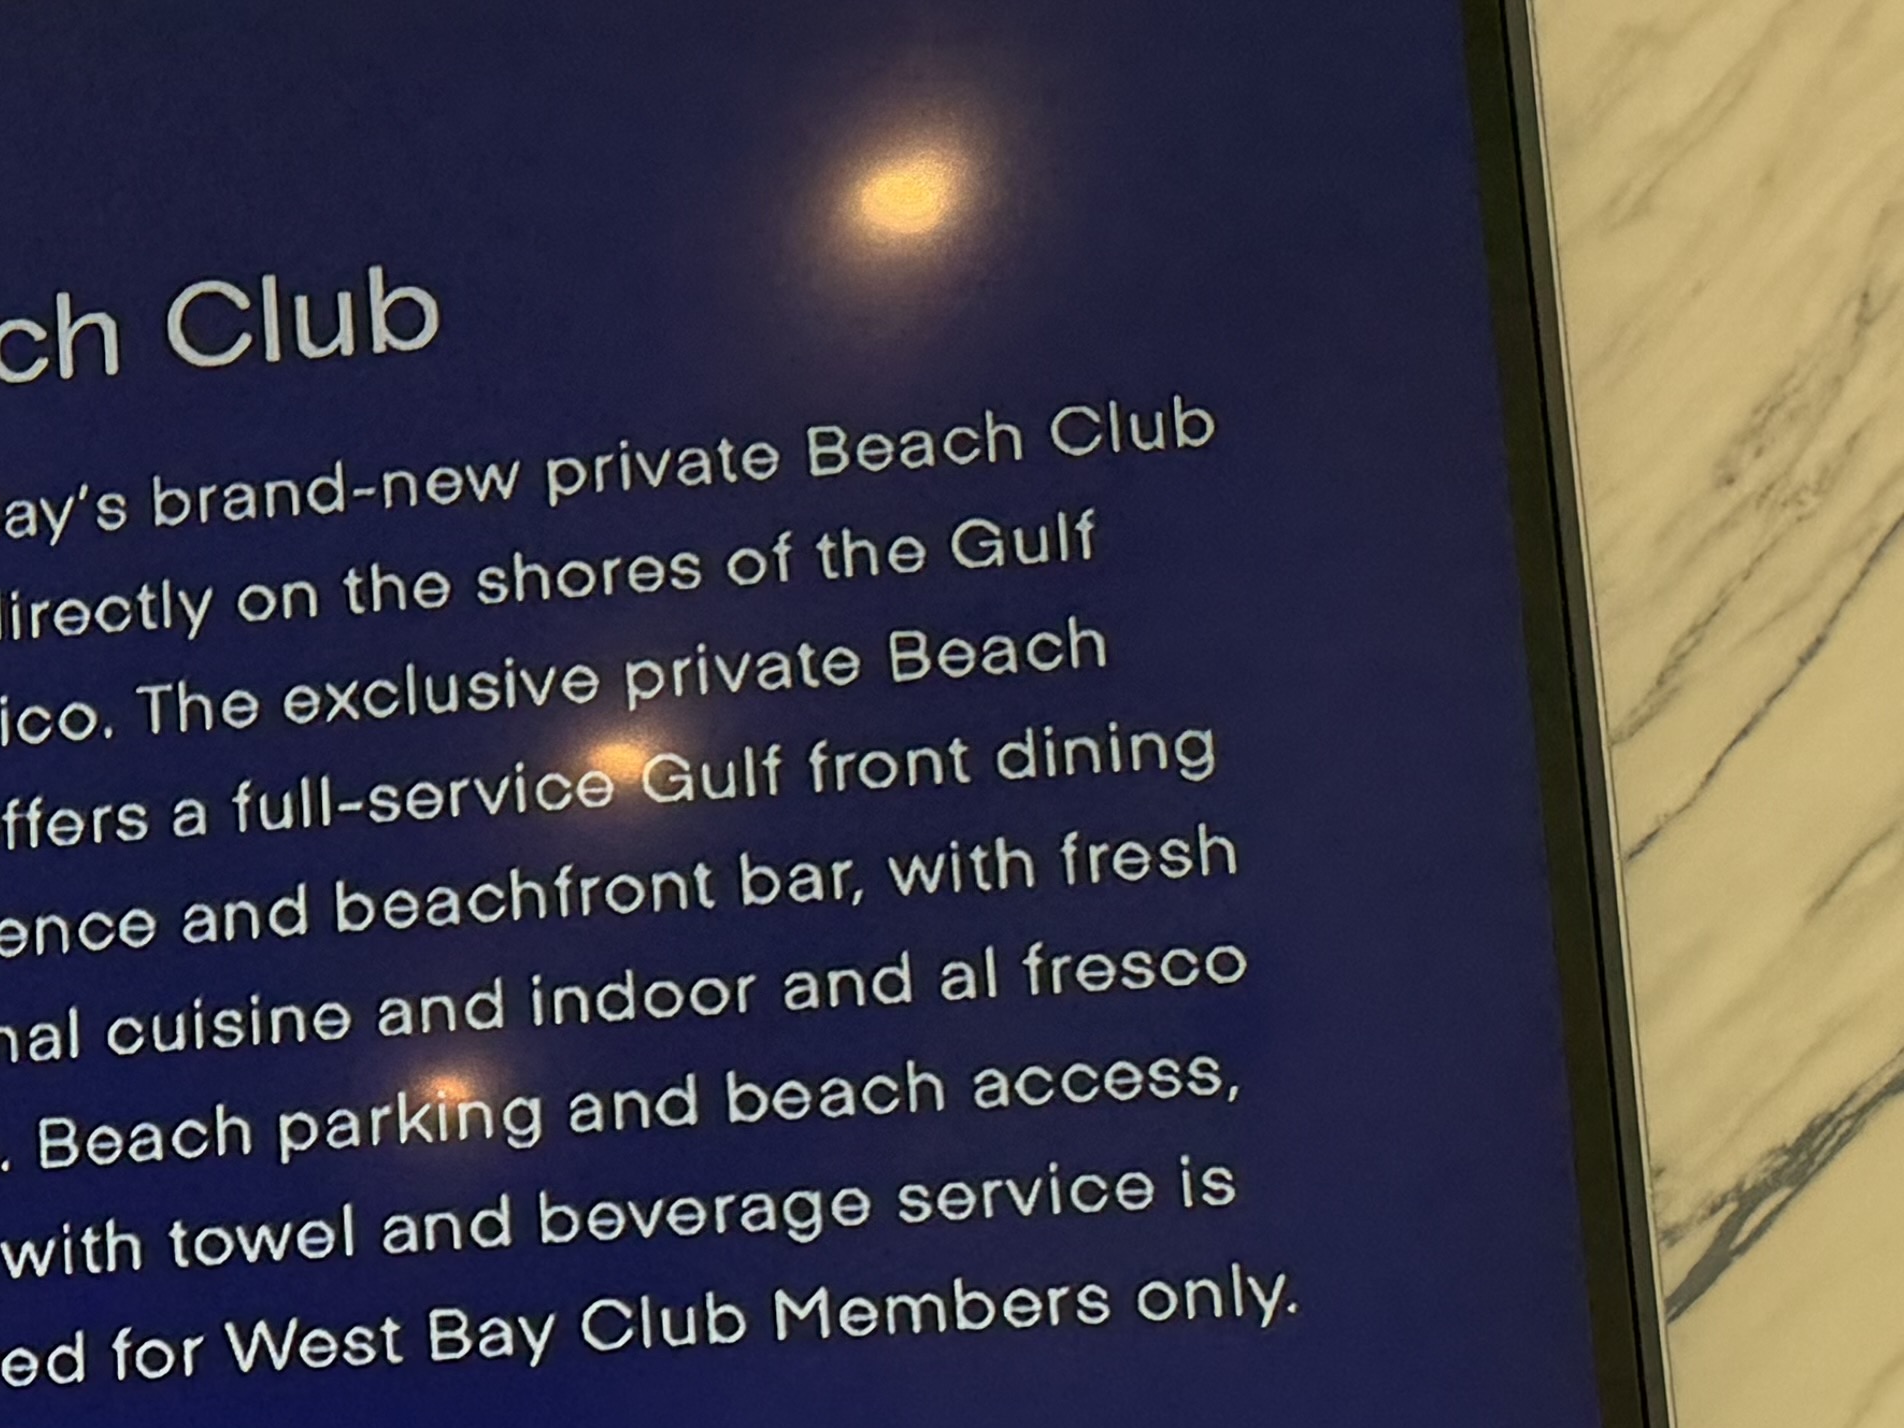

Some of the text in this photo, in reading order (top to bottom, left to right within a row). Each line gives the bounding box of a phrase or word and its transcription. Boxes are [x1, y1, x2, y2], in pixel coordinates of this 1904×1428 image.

[168, 266, 438, 366] Club
[153, 461, 519, 526] brand-new
[547, 438, 779, 506] private
[807, 410, 1021, 476] Beach
[1051, 395, 1214, 455] Club
[238, 581, 317, 621] on
[343, 563, 450, 613] the
[478, 552, 701, 603] shores
[728, 531, 791, 585] of
[816, 528, 925, 578] the
[952, 508, 1094, 568] Gulf
[136, 680, 258, 734] The
[284, 657, 599, 724] exclusive
[626, 643, 859, 711] private
[890, 616, 1105, 682] Beach
[174, 799, 206, 837] a
[232, 762, 614, 832] full-service
[643, 744, 781, 802] Gulf
[809, 738, 970, 792] front
[998, 722, 1214, 781] dining
[183, 883, 307, 943] and
[336, 863, 715, 932] beachfront
[740, 853, 863, 905] bar,
[888, 837, 1034, 896] with
[1061, 823, 1236, 885] fresh
[108, 994, 350, 1055] cuisine
[379, 977, 503, 1036] and
[532, 969, 756, 1026] indoor
[785, 951, 911, 1010] and
[942, 946, 996, 1000] al
[1023, 942, 1246, 995] fresco
[39, 1104, 251, 1168] Beach
[280, 1086, 541, 1164] parking
[570, 1073, 697, 1132] and
[727, 1060, 944, 1122] beach
[974, 1057, 1238, 1108] access,
[0, 1218, 141, 1278] with
[169, 1203, 353, 1267] towel
[383, 1193, 511, 1253] and
[540, 1188, 870, 1243] beverage
[899, 1162, 1154, 1222] service
[1181, 1155, 1235, 1207] is
[112, 1327, 204, 1380] for
[225, 1317, 403, 1372] West
[429, 1308, 555, 1367] Bay
[582, 1291, 746, 1350] Club
[775, 1278, 1110, 1340] Members
[1138, 1263, 1296, 1327] only.
